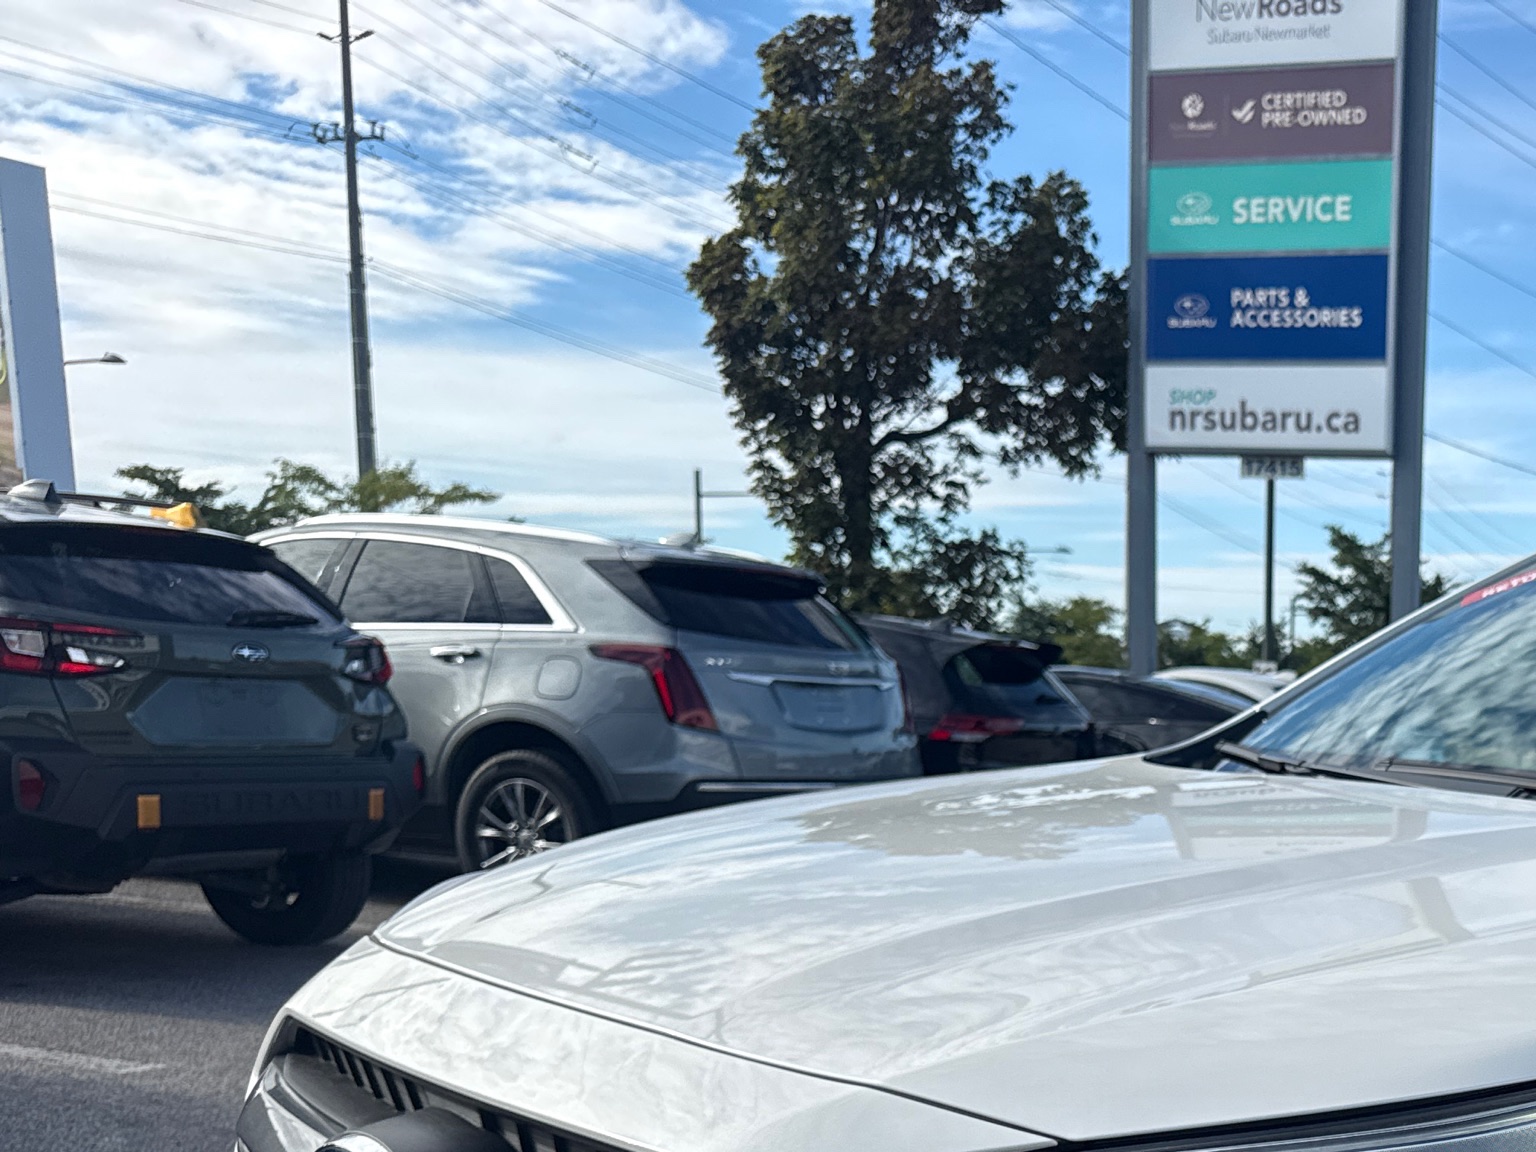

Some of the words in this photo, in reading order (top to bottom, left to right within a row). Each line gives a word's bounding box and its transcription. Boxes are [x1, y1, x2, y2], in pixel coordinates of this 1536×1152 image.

[1261, 89, 1348, 111] CERTIFIED
[1261, 106, 1367, 128] PRE-OWNED
[1232, 195, 1353, 224] SERVICE
[1230, 287, 1290, 308] PARTS
[1294, 286, 1310, 308] &
[1230, 306, 1363, 328] ACCESSORIES
[1169, 388, 1217, 404] SHOP
[1168, 397, 1361, 434] nrsubaru.ca
